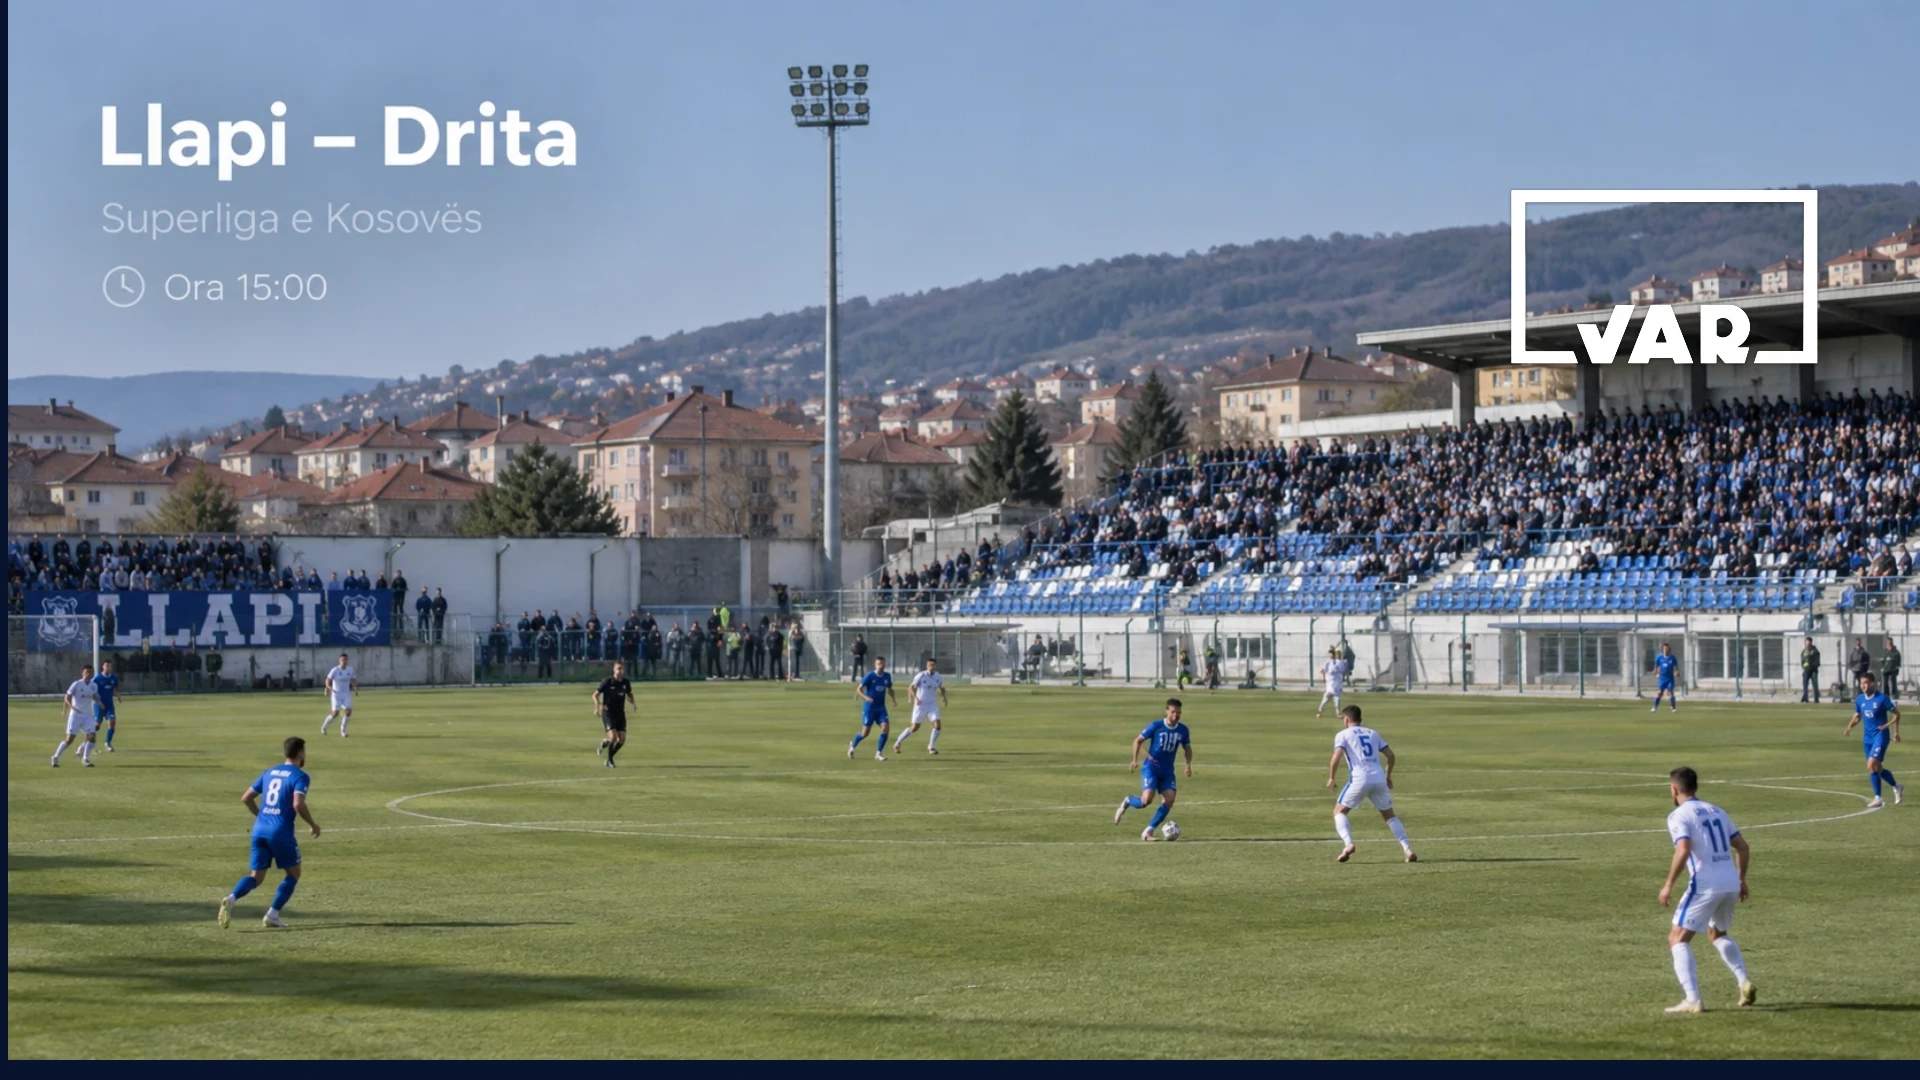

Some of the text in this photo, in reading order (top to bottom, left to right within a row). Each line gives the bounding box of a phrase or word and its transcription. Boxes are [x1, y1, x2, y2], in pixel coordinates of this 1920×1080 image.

[97, 593, 321, 646] LLAPI
[1359, 735, 1373, 757] 5
[266, 778, 282, 806] 8
[1702, 819, 1728, 853] 11
